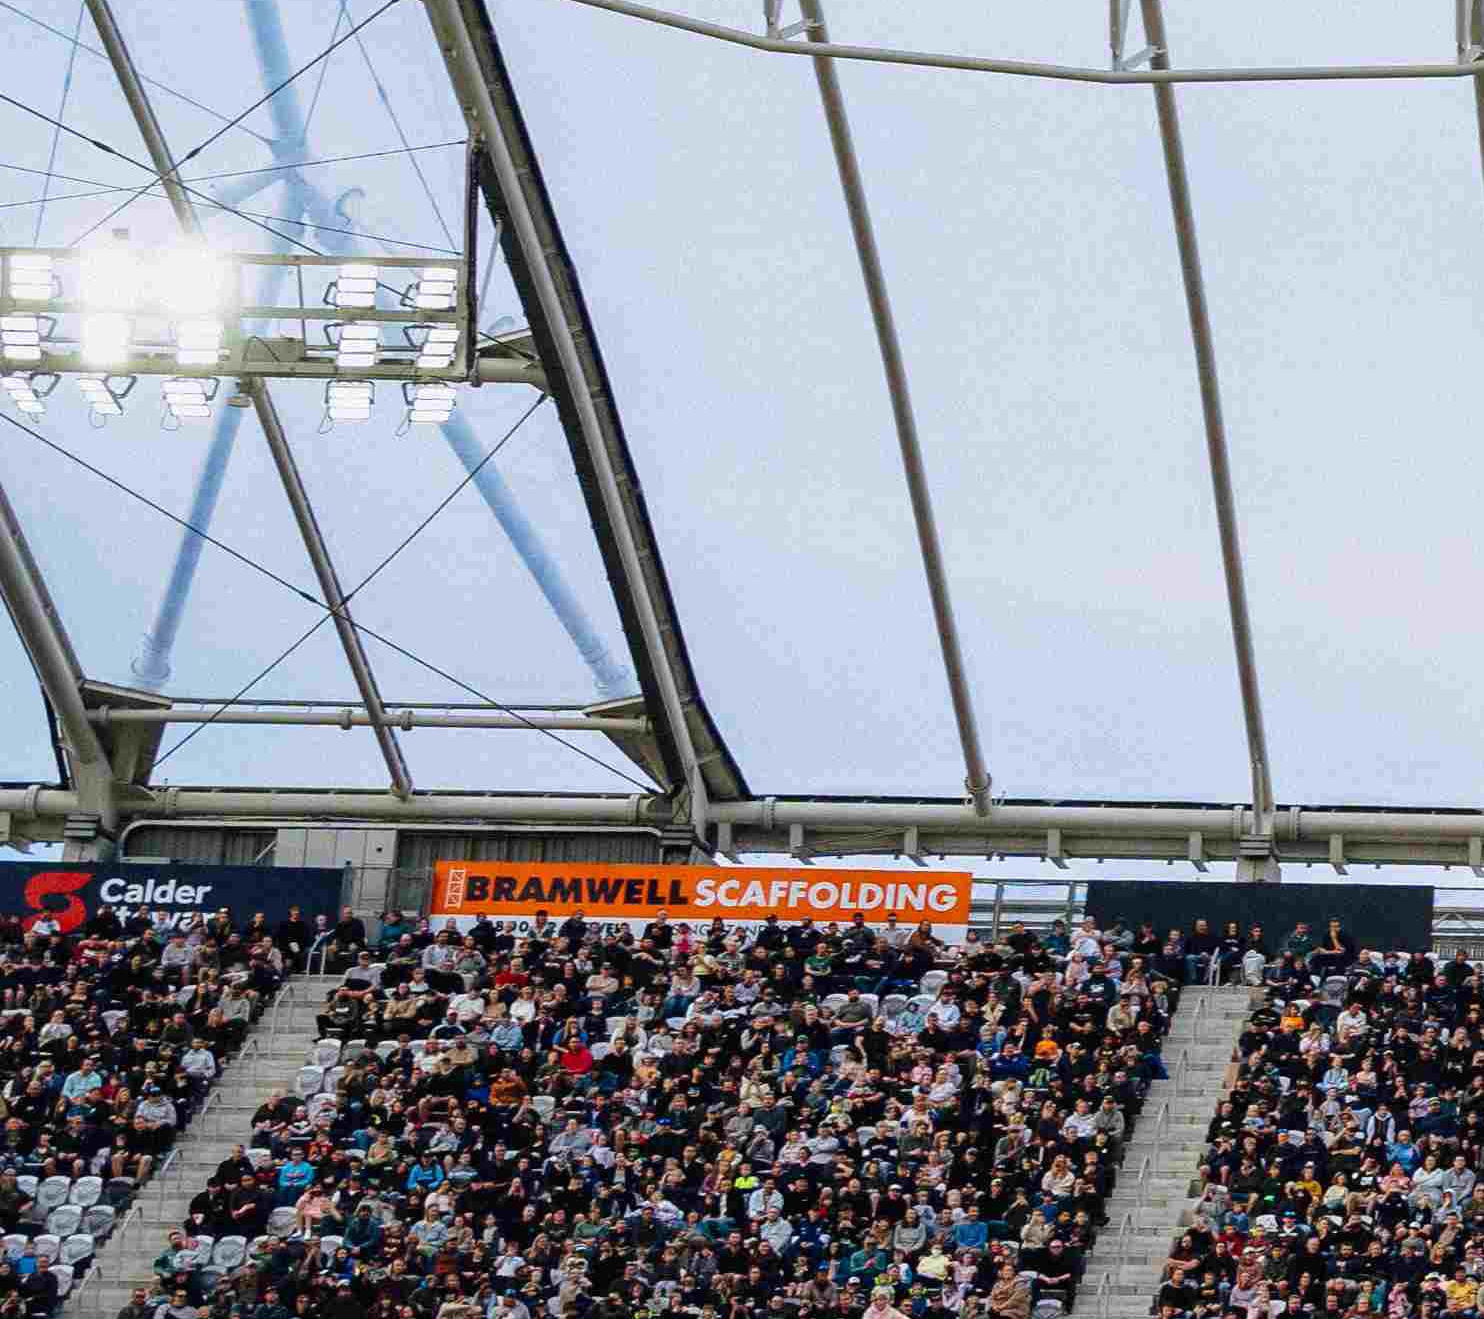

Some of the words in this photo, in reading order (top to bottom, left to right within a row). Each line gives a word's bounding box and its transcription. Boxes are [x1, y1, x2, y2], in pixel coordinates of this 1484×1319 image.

[100, 877, 213, 904] Calder
[466, 875, 689, 906] BRAMWELL
[693, 878, 959, 912] SCAFFOLDING
